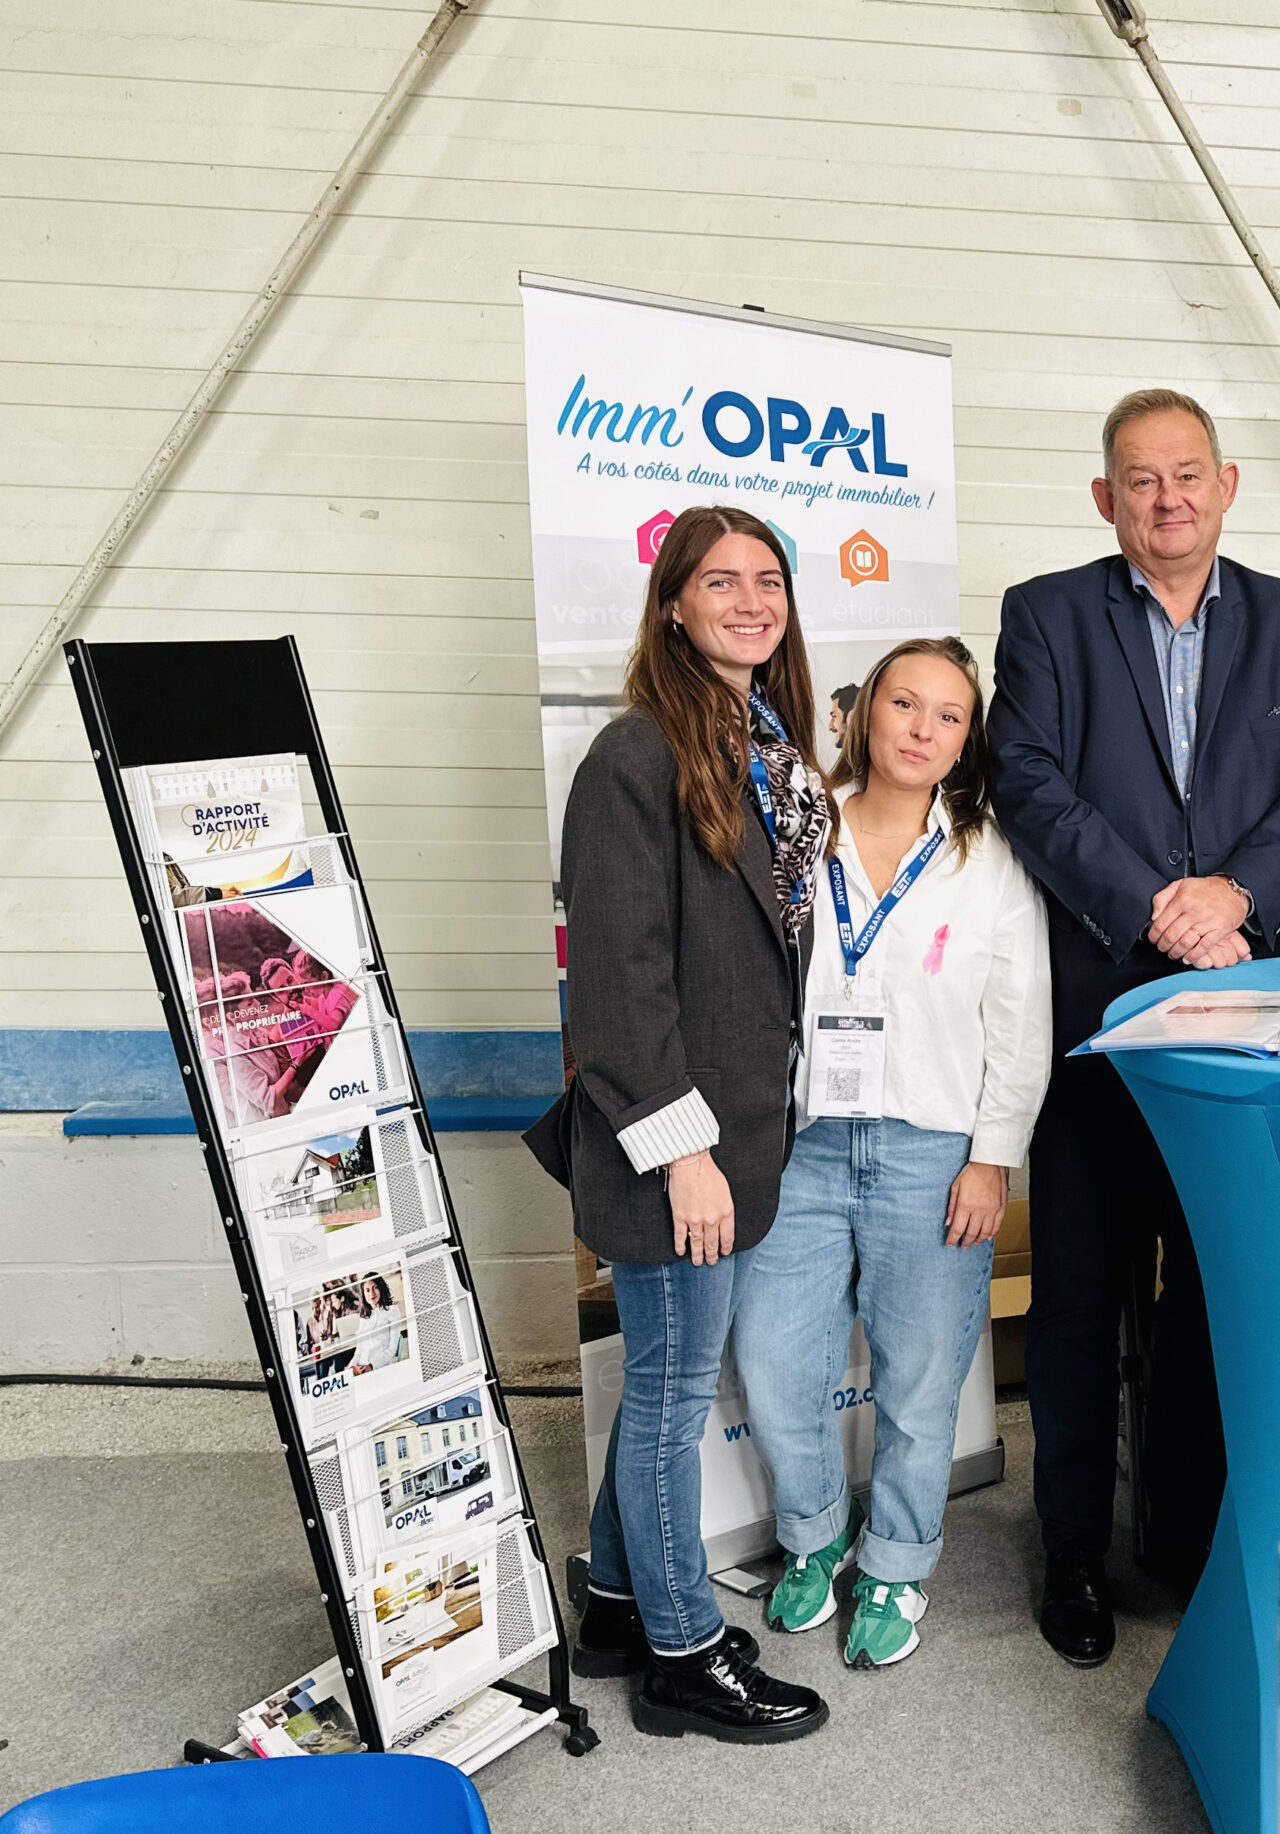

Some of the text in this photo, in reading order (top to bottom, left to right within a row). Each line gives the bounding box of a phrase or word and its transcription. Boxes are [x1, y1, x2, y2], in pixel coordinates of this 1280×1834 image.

[577, 452, 591, 474] A
[597, 461, 630, 479] vos
[634, 461, 682, 482] côtés
[687, 464, 730, 488] dans
[735, 473, 780, 492] votre
[781, 480, 834, 508] projet
[836, 484, 922, 510] immobilier
[195, 803, 261, 820] RAPPORT
[192, 813, 269, 836] D'ACTIVITÉ
[206, 828, 257, 854] 2024
[920, 830, 944, 862] EXPOSA
[832, 864, 845, 906] EXPOSANT
[856, 909, 886, 954] EXPOSANT
[234, 1005, 269, 1019] DEVENEZ
[236, 1011, 302, 1033] PROPRIÉTAIRE
[329, 1080, 369, 1100] OPAL
[312, 1375, 349, 1398] OPAL
[395, 1505, 432, 1530] OPAL
